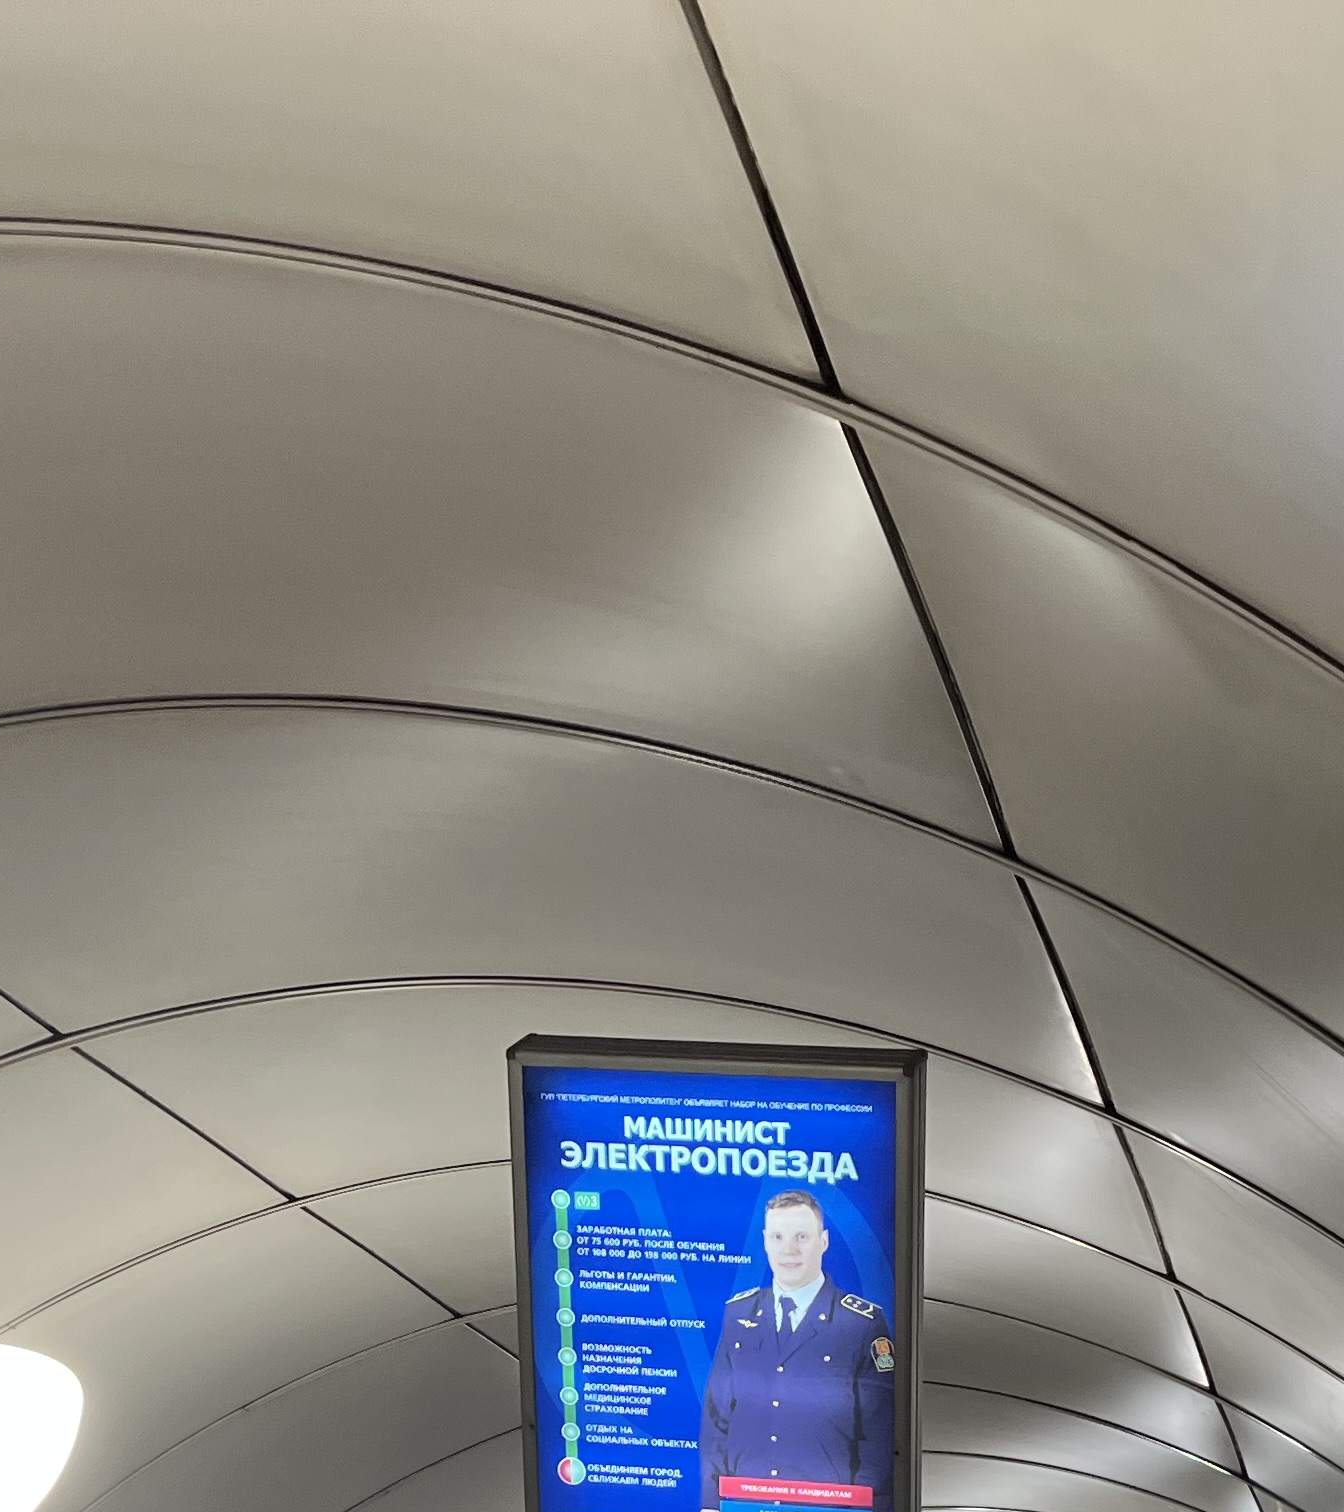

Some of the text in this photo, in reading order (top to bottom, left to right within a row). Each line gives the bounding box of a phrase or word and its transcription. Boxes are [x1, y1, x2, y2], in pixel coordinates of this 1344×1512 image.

[730, 1100, 756, 1109] НАБОР
[757, 1101, 768, 1110] НА
[769, 1101, 809, 1111] ОБУЧЕНИЕ
[811, 1103, 823, 1112] ПО
[824, 1103, 873, 1113] ПРОФЕССИИ
[623, 1115, 791, 1146] МАШИНИСТ
[560, 1140, 859, 1185] ЭЛЕКТРОПОЕЗДА
[576, 1225, 672, 1238] ЗАРАБОТНАЯ ПЛАТА:
[576, 1237, 725, 1252] ОТ 75 600 РУБ. ПОСЛЕ ОБУЧЕНИЯ
[577, 1248, 589, 1256] ОТ
[609, 1249, 626, 1258] 000
[627, 1250, 642, 1260] ДО
[661, 1251, 678, 1261] 000
[680, 1252, 699, 1262] РУБ.
[702, 1254, 716, 1263] НА
[718, 1255, 752, 1264] ЛИНИИ
[579, 1269, 615, 1280] ЛЬГОТЫ
[617, 1271, 625, 1280] И
[579, 1280, 650, 1293] КОМПЕНСАЦИИ
[581, 1314, 706, 1329] ДОПОЛНИТЕЛЬНЫЙ ОТПУСК
[582, 1343, 652, 1355] ВОЗМОЖНОСТЬ
[582, 1354, 642, 1365] НАЗНАЧЕНИЯ
[583, 1365, 678, 1378] ДОСРОЧНОЙ ПЕНСИИ
[583, 1382, 667, 1395] ДОПОЛНИТЕЛЬНОЕ
[584, 1393, 652, 1405] МЕДИЦИНСКОЕ
[584, 1404, 649, 1416] СТРАХОВАНИЕ
[585, 1424, 633, 1434] ОТДЫХ НА
[586, 1435, 698, 1449] СОЦИАЛЬНЫХ ОБЪЕКТАХ
[588, 1463, 650, 1476] ОБЪЕДИНЯЕМ
[588, 1475, 677, 1488] СБЛИЖАЕМ ЛЮДЕЙ!
[797, 1488, 852, 1499] КАНДИДАТАМ
